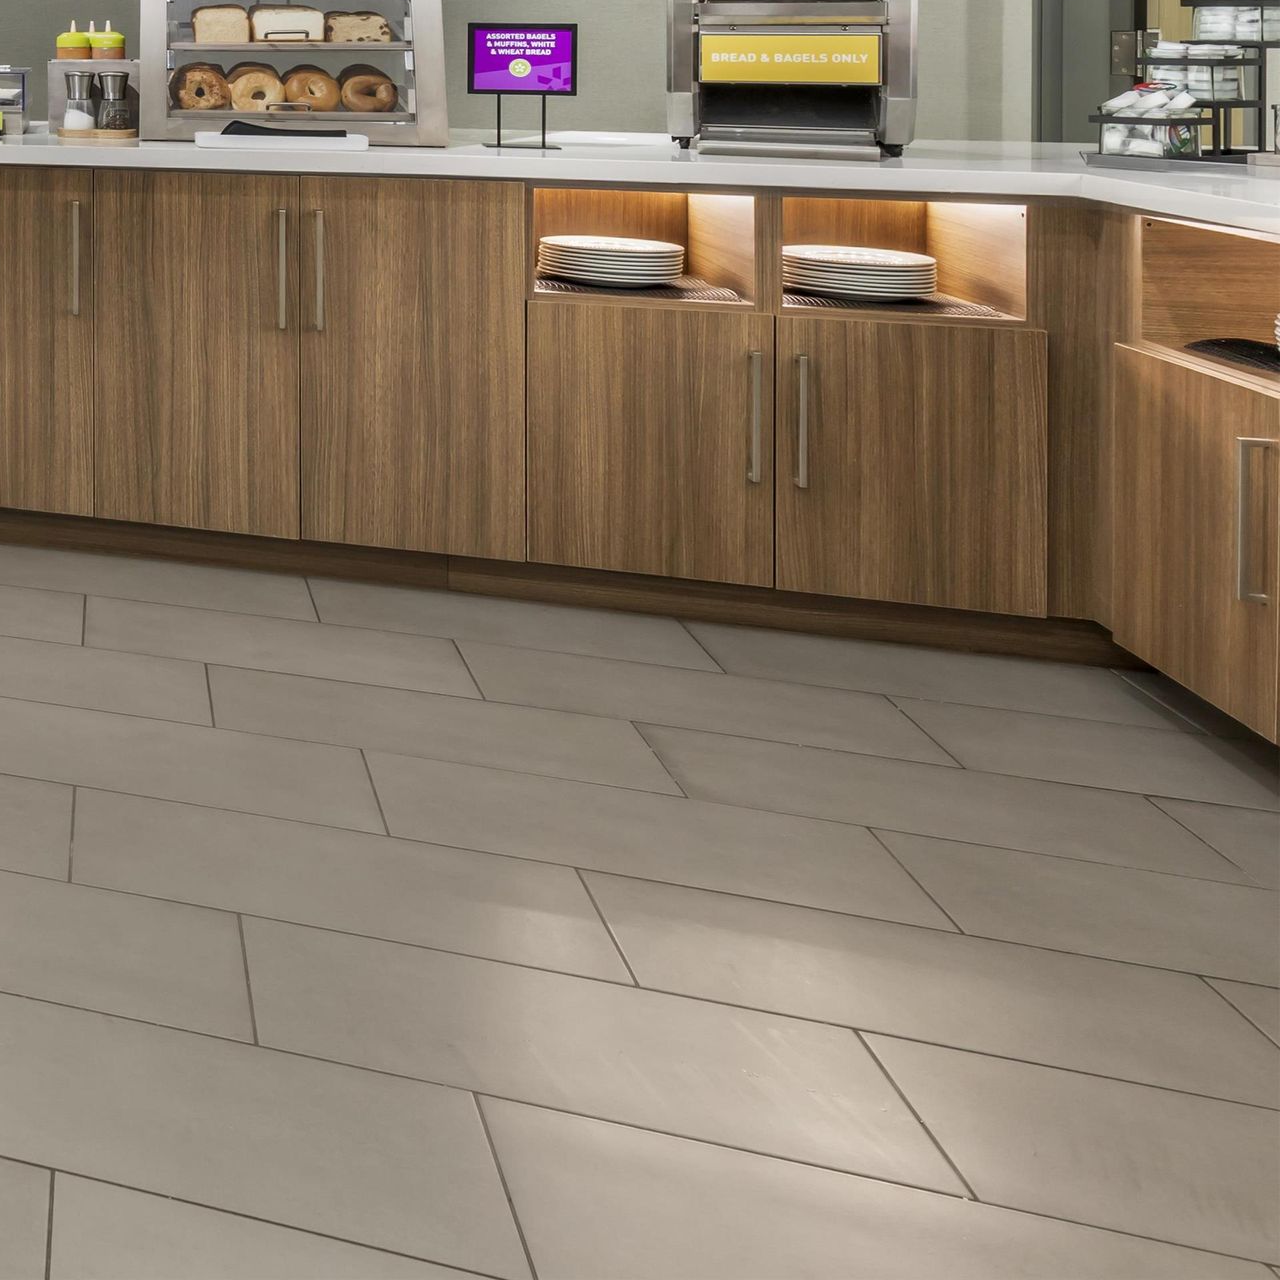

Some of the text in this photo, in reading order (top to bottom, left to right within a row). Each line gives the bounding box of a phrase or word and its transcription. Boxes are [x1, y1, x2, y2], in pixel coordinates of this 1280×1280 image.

[711, 52, 869, 64] BREAD & BAGELS ONLY
